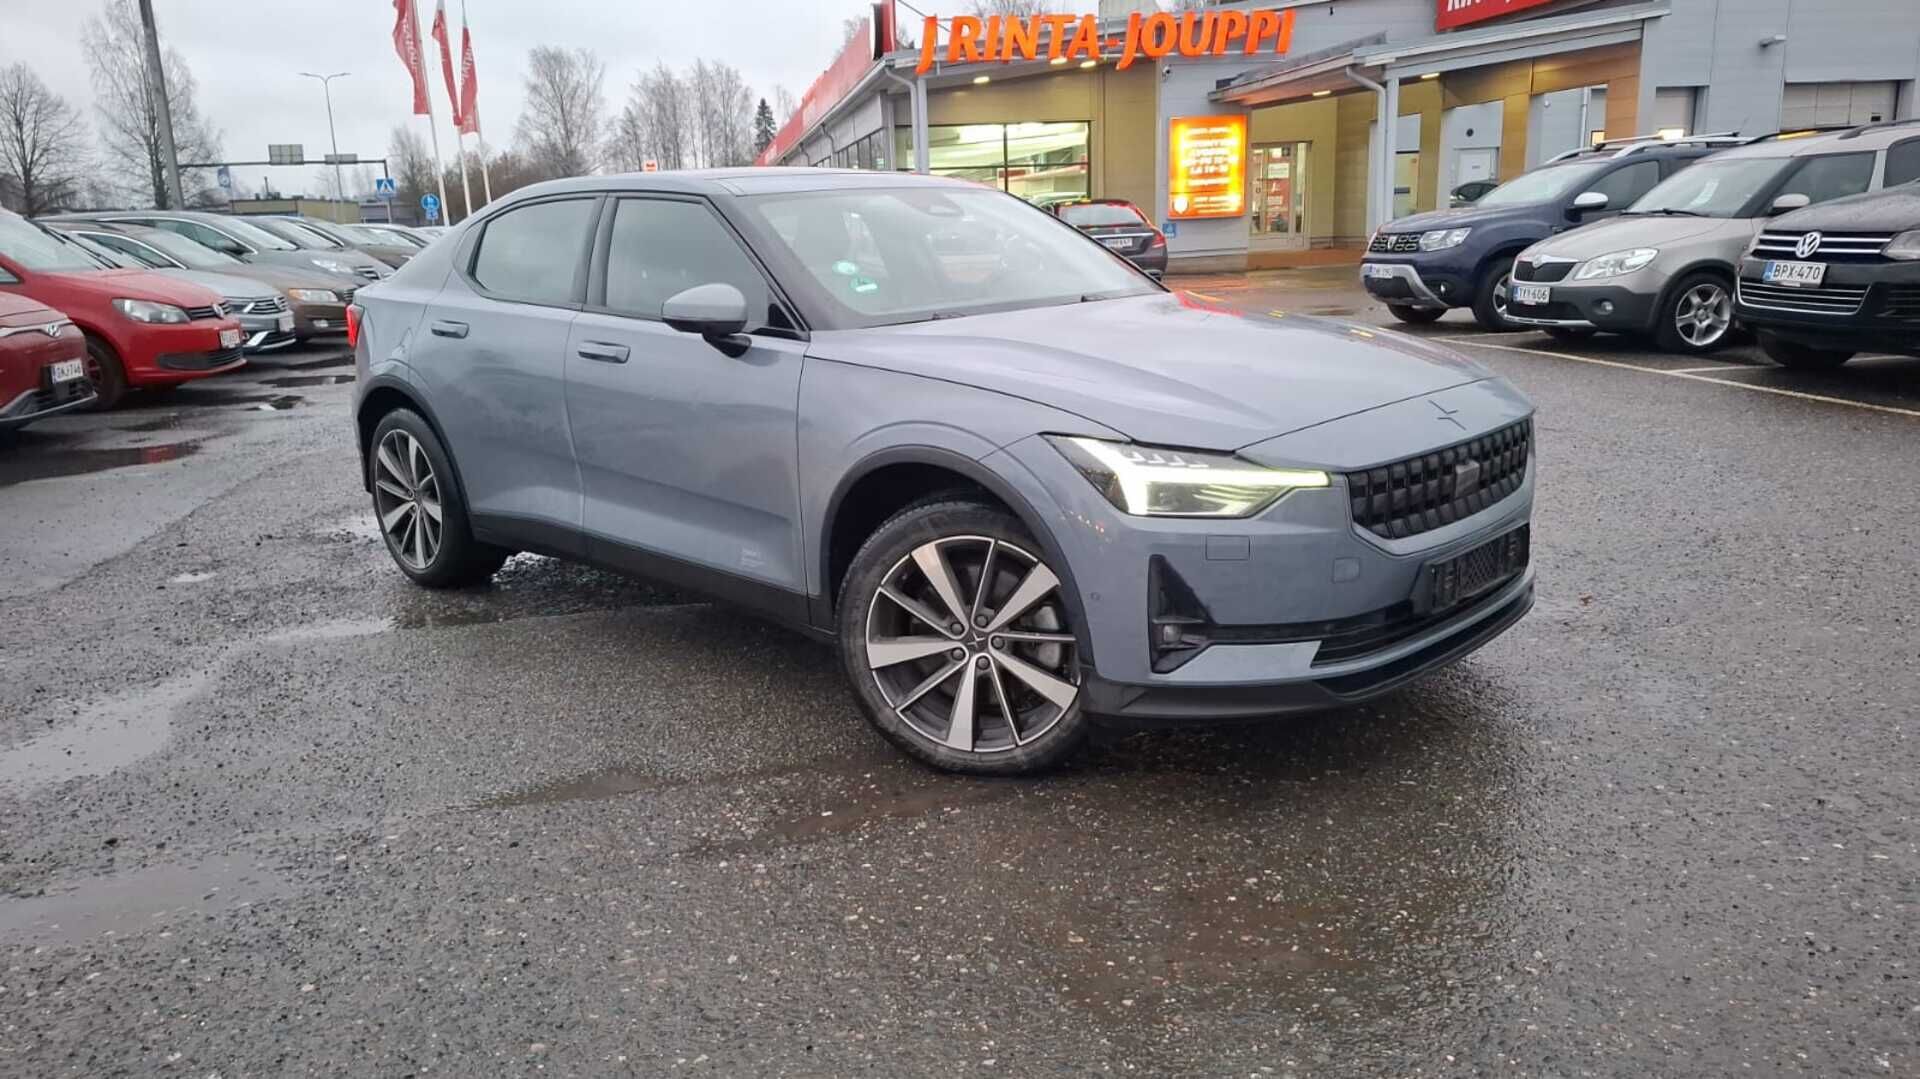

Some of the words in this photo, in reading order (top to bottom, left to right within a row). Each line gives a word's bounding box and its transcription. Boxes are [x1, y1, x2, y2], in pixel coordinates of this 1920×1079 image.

[916, 15, 938, 75] J
[947, 8, 1297, 70] RINTA-JOUPPI
[1773, 263, 1821, 280] BPX-470
